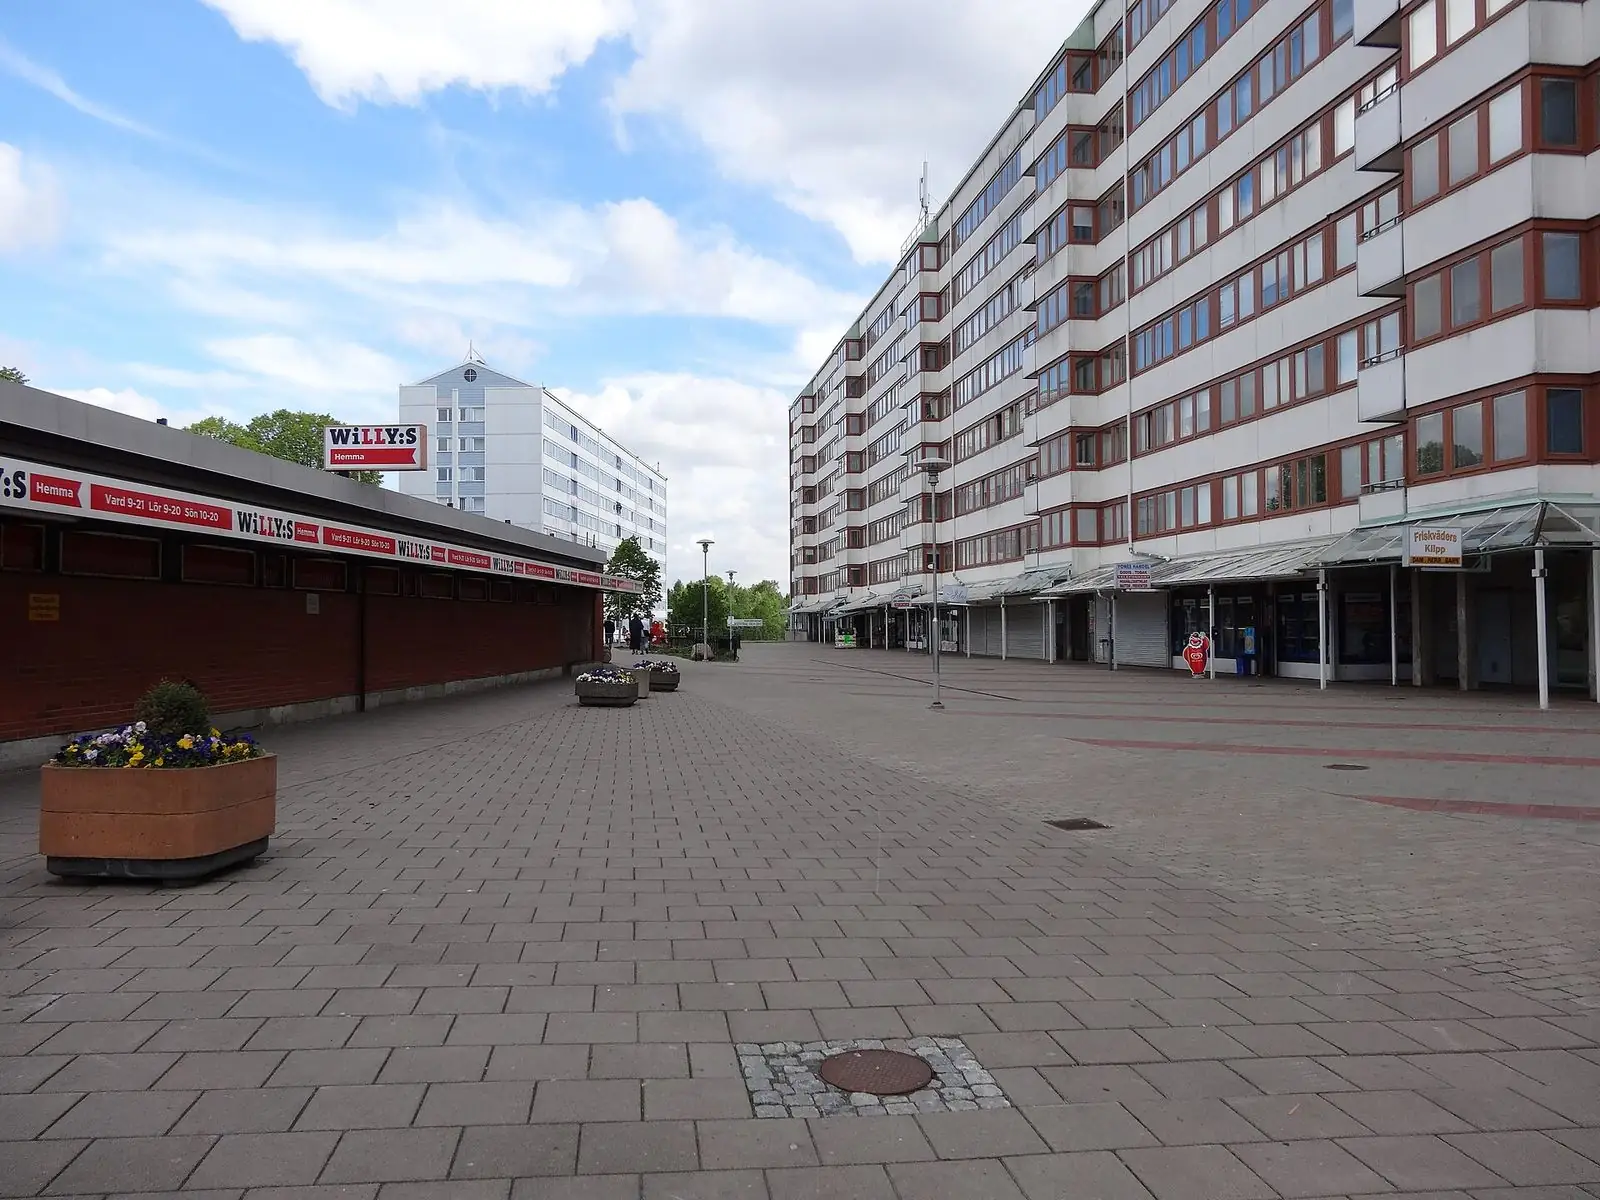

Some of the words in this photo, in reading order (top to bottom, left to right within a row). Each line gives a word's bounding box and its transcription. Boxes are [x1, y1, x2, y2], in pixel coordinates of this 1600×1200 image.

[0, 467, 27, 499] :S
[36, 481, 74, 498] Hemma
[104, 493, 126, 507] Vard
[127, 498, 145, 510] 9-21
[148, 501, 162, 513] Lör
[163, 504, 181, 516] 9-20
[184, 507, 199, 519] Sön
[199, 510, 219, 522] 10-20
[297, 527, 315, 538] Hemma
[1425, 545, 1445, 554] Klipp
